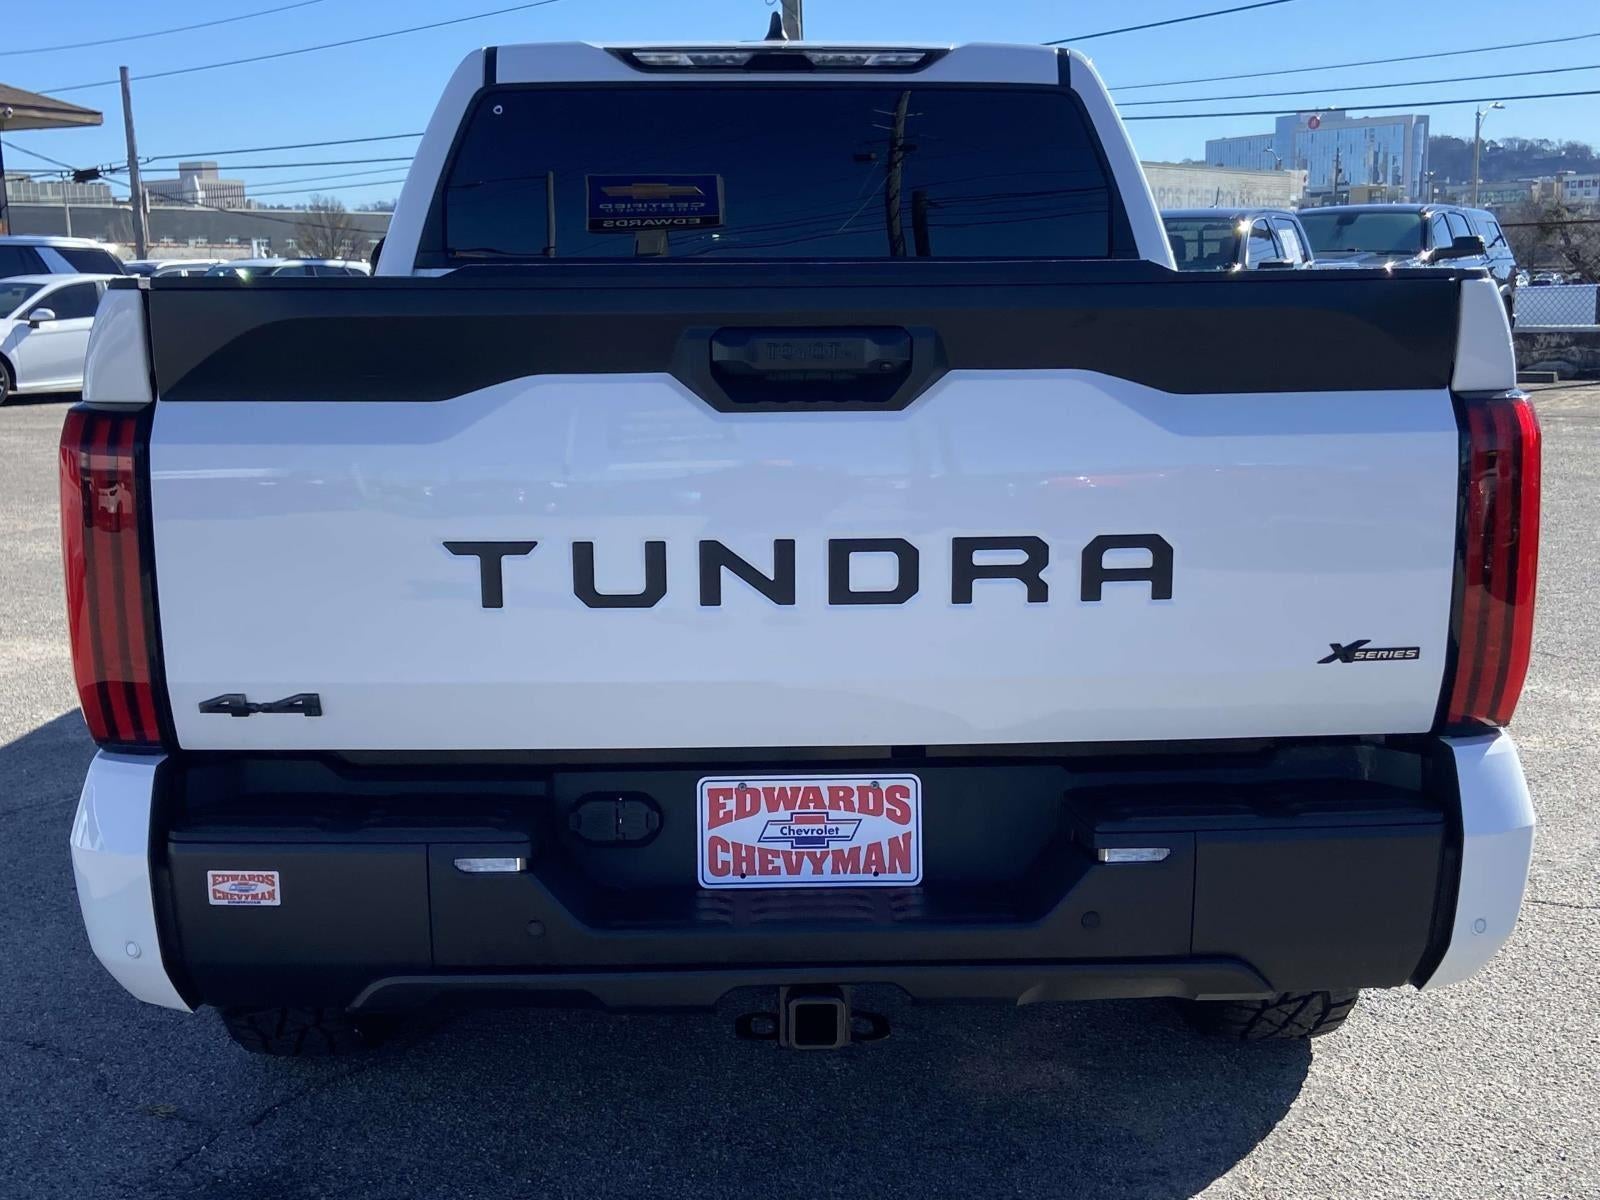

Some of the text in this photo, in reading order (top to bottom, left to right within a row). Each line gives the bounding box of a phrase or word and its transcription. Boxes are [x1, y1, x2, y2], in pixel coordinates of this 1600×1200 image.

[443, 534, 1174, 609] TUNDRA
[707, 785, 912, 830] EDWARDS
[780, 825, 840, 837] Chevrolet
[708, 831, 912, 878] CHEVYMAN
[212, 874, 275, 886] EDWARDS
[213, 888, 275, 900] CHEVYMAN
